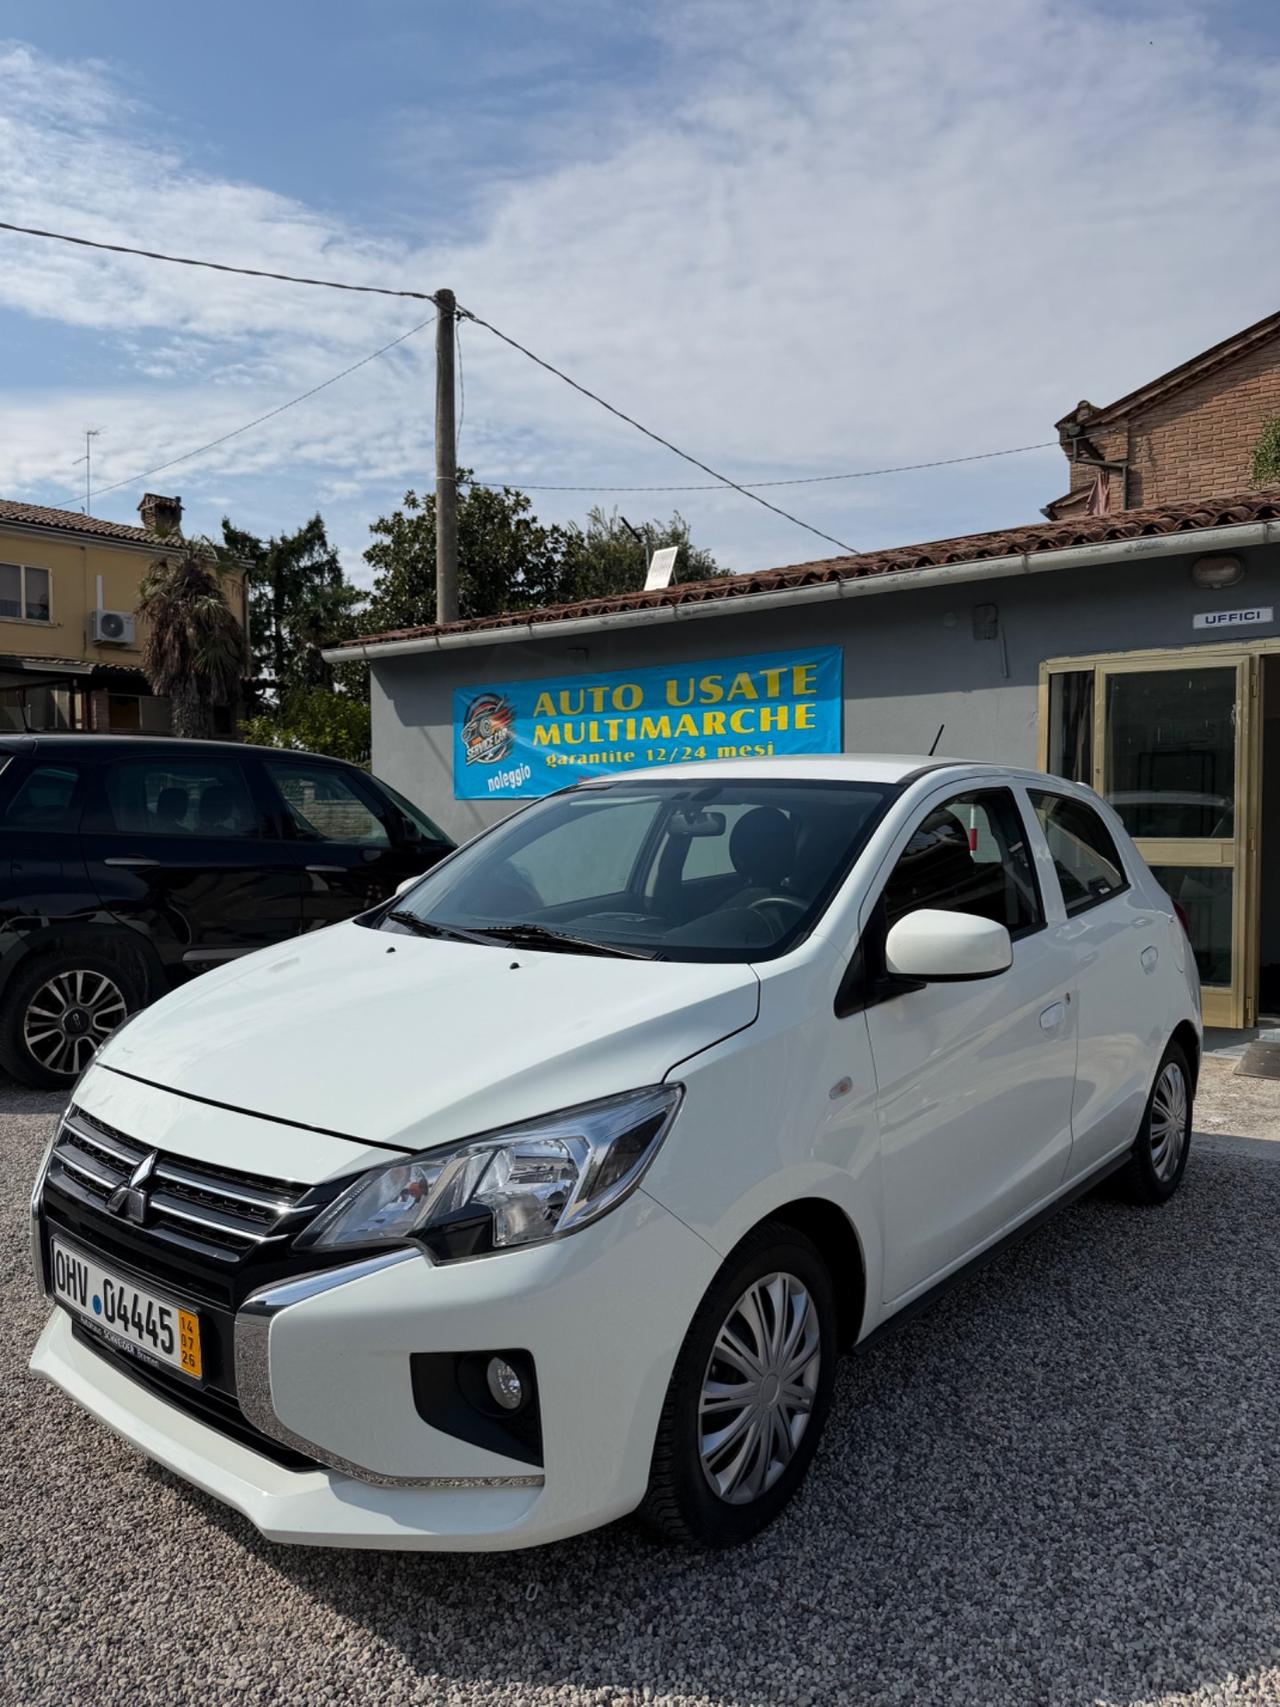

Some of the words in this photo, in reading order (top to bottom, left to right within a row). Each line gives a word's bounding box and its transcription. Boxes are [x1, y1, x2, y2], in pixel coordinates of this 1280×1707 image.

[1205, 610, 1260, 624] UFFICI
[533, 684, 644, 718] AUTO
[666, 664, 817, 707] USATE
[532, 703, 816, 746] MULTIMARCHE
[546, 750, 635, 768] garantite
[646, 745, 707, 763] 12/24
[717, 741, 774, 758] mesi
[487, 763, 531, 792] noleggio
[55, 1249, 88, 1307] OHV
[103, 1278, 174, 1354] 04445
[181, 1316, 193, 1334] 14
[181, 1333, 194, 1350] 07
[182, 1350, 195, 1367] 26
